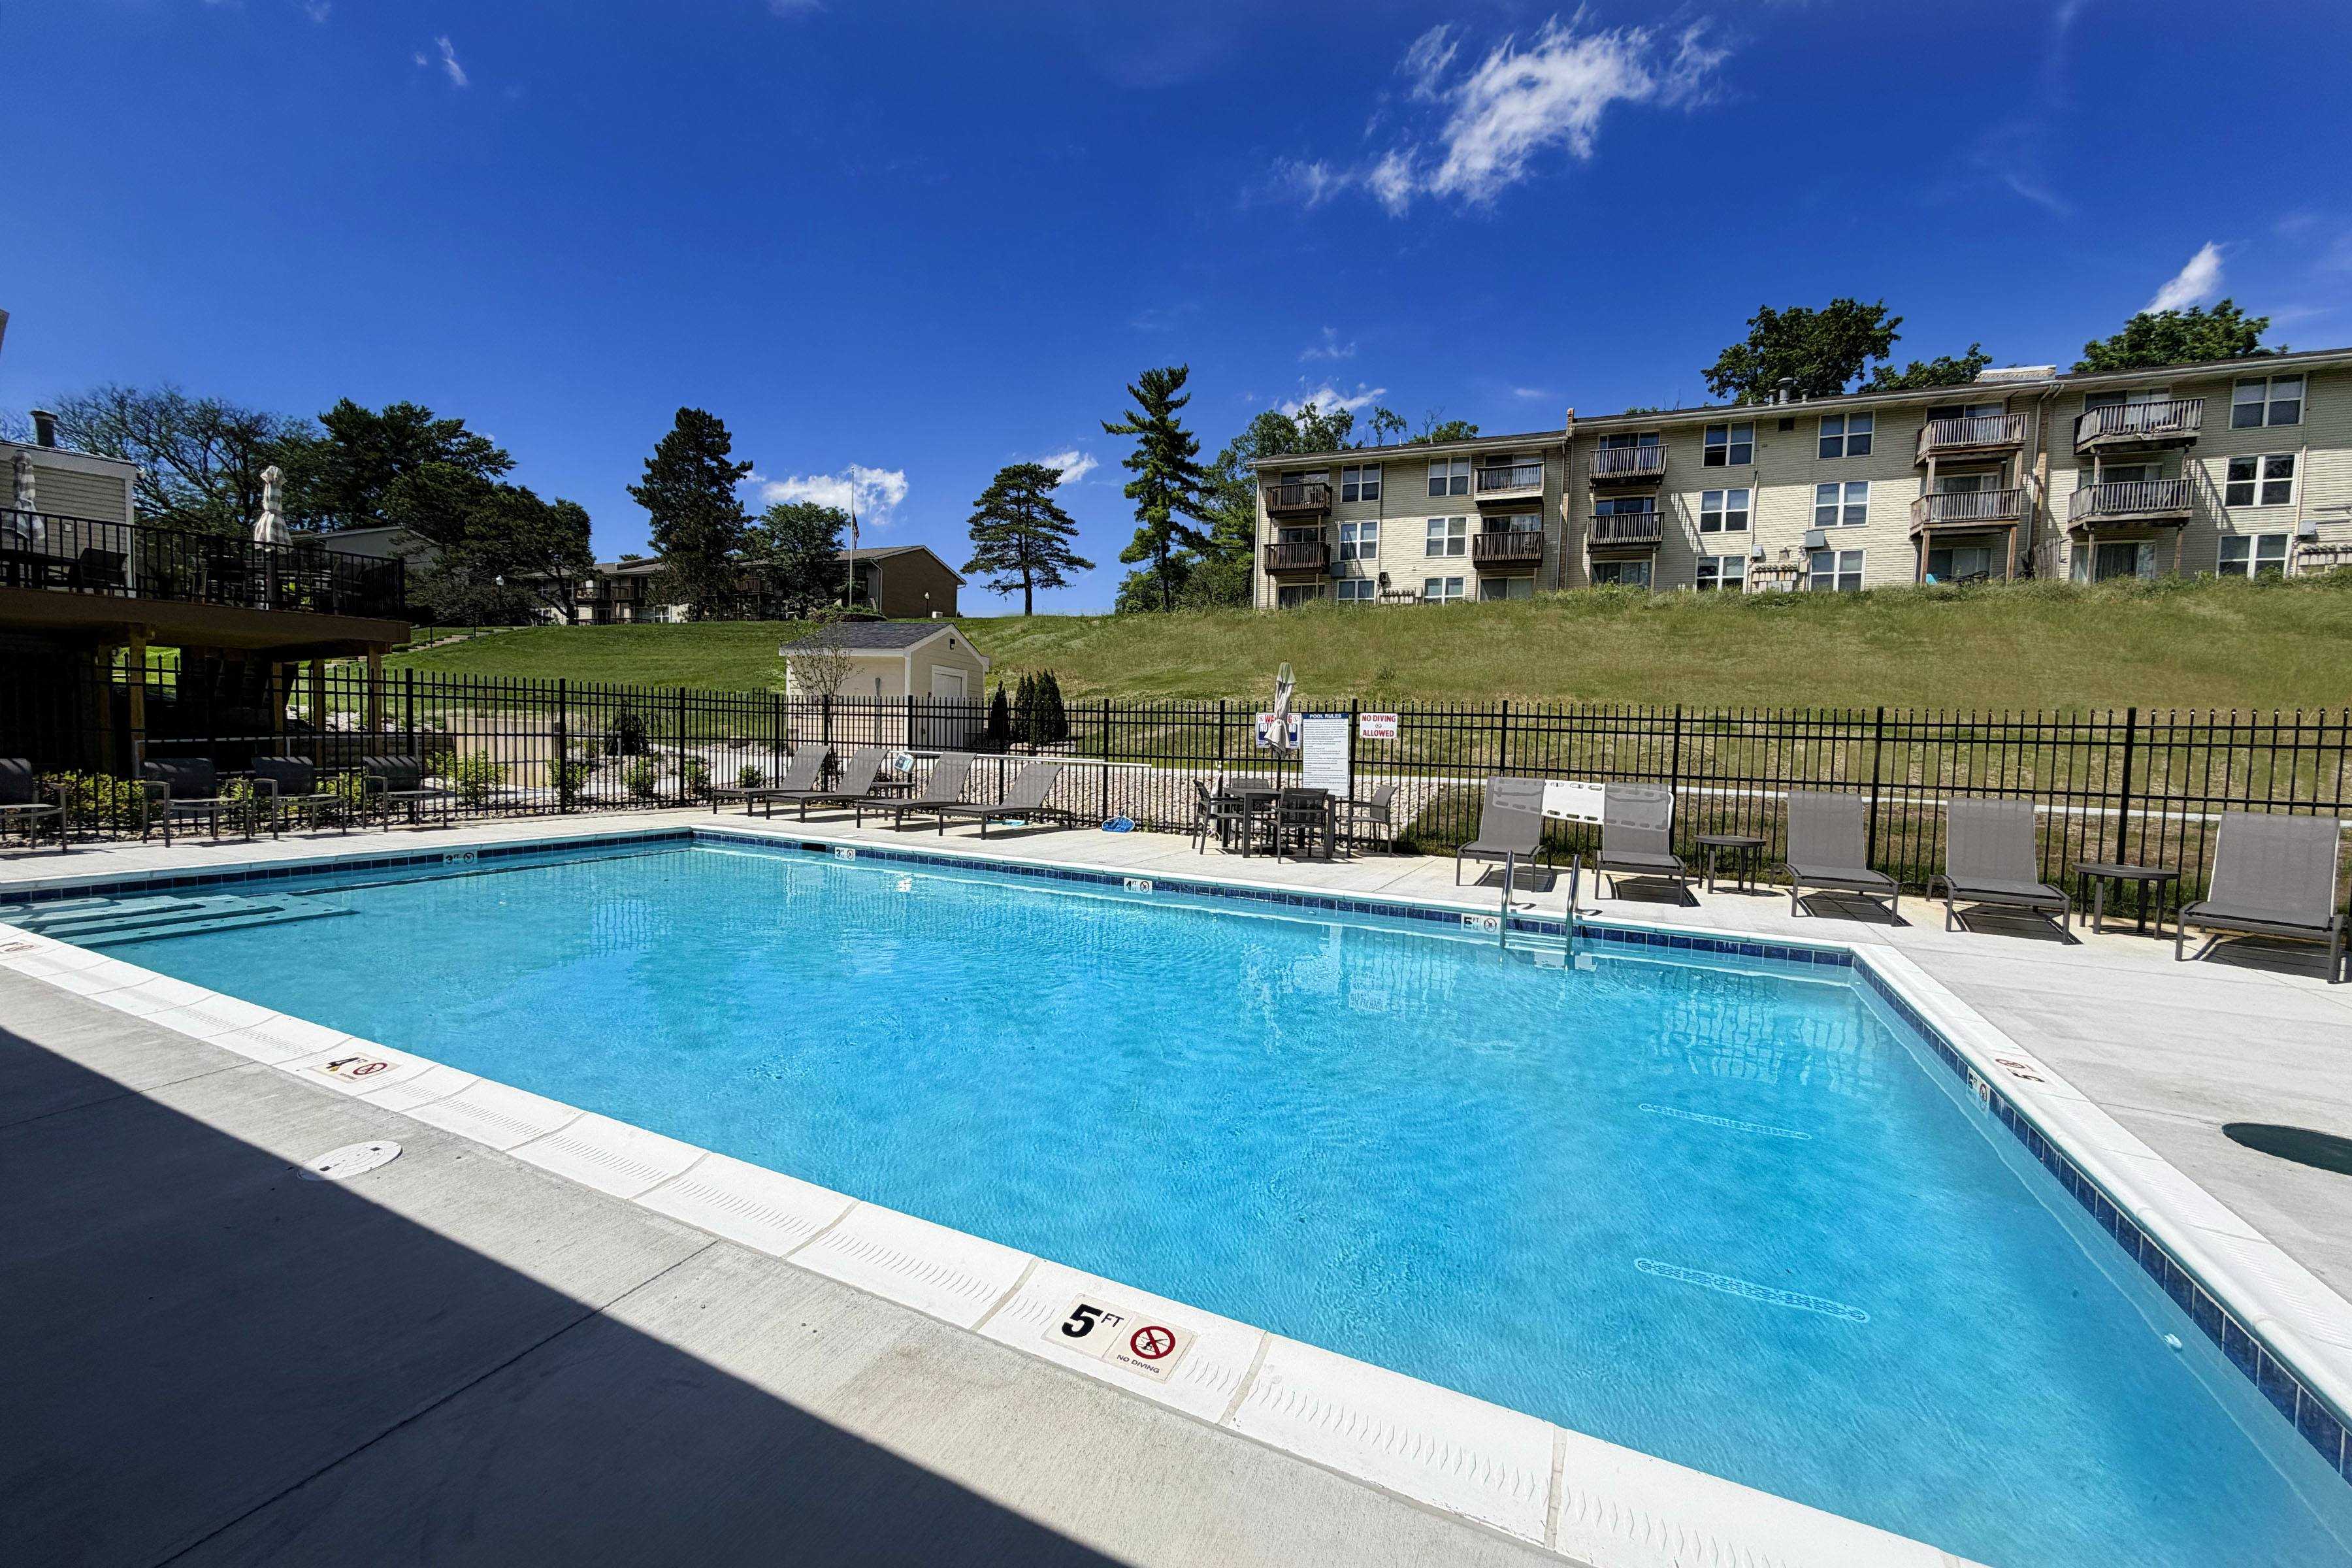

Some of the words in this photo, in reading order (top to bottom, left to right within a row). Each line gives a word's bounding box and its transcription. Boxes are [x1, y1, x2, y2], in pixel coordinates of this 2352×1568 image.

[1061, 1303, 1104, 1338] 5
[1100, 1313, 1124, 1328] FT
[1117, 1354, 1130, 1363] NO
[1131, 1359, 1160, 1374] DIVING
